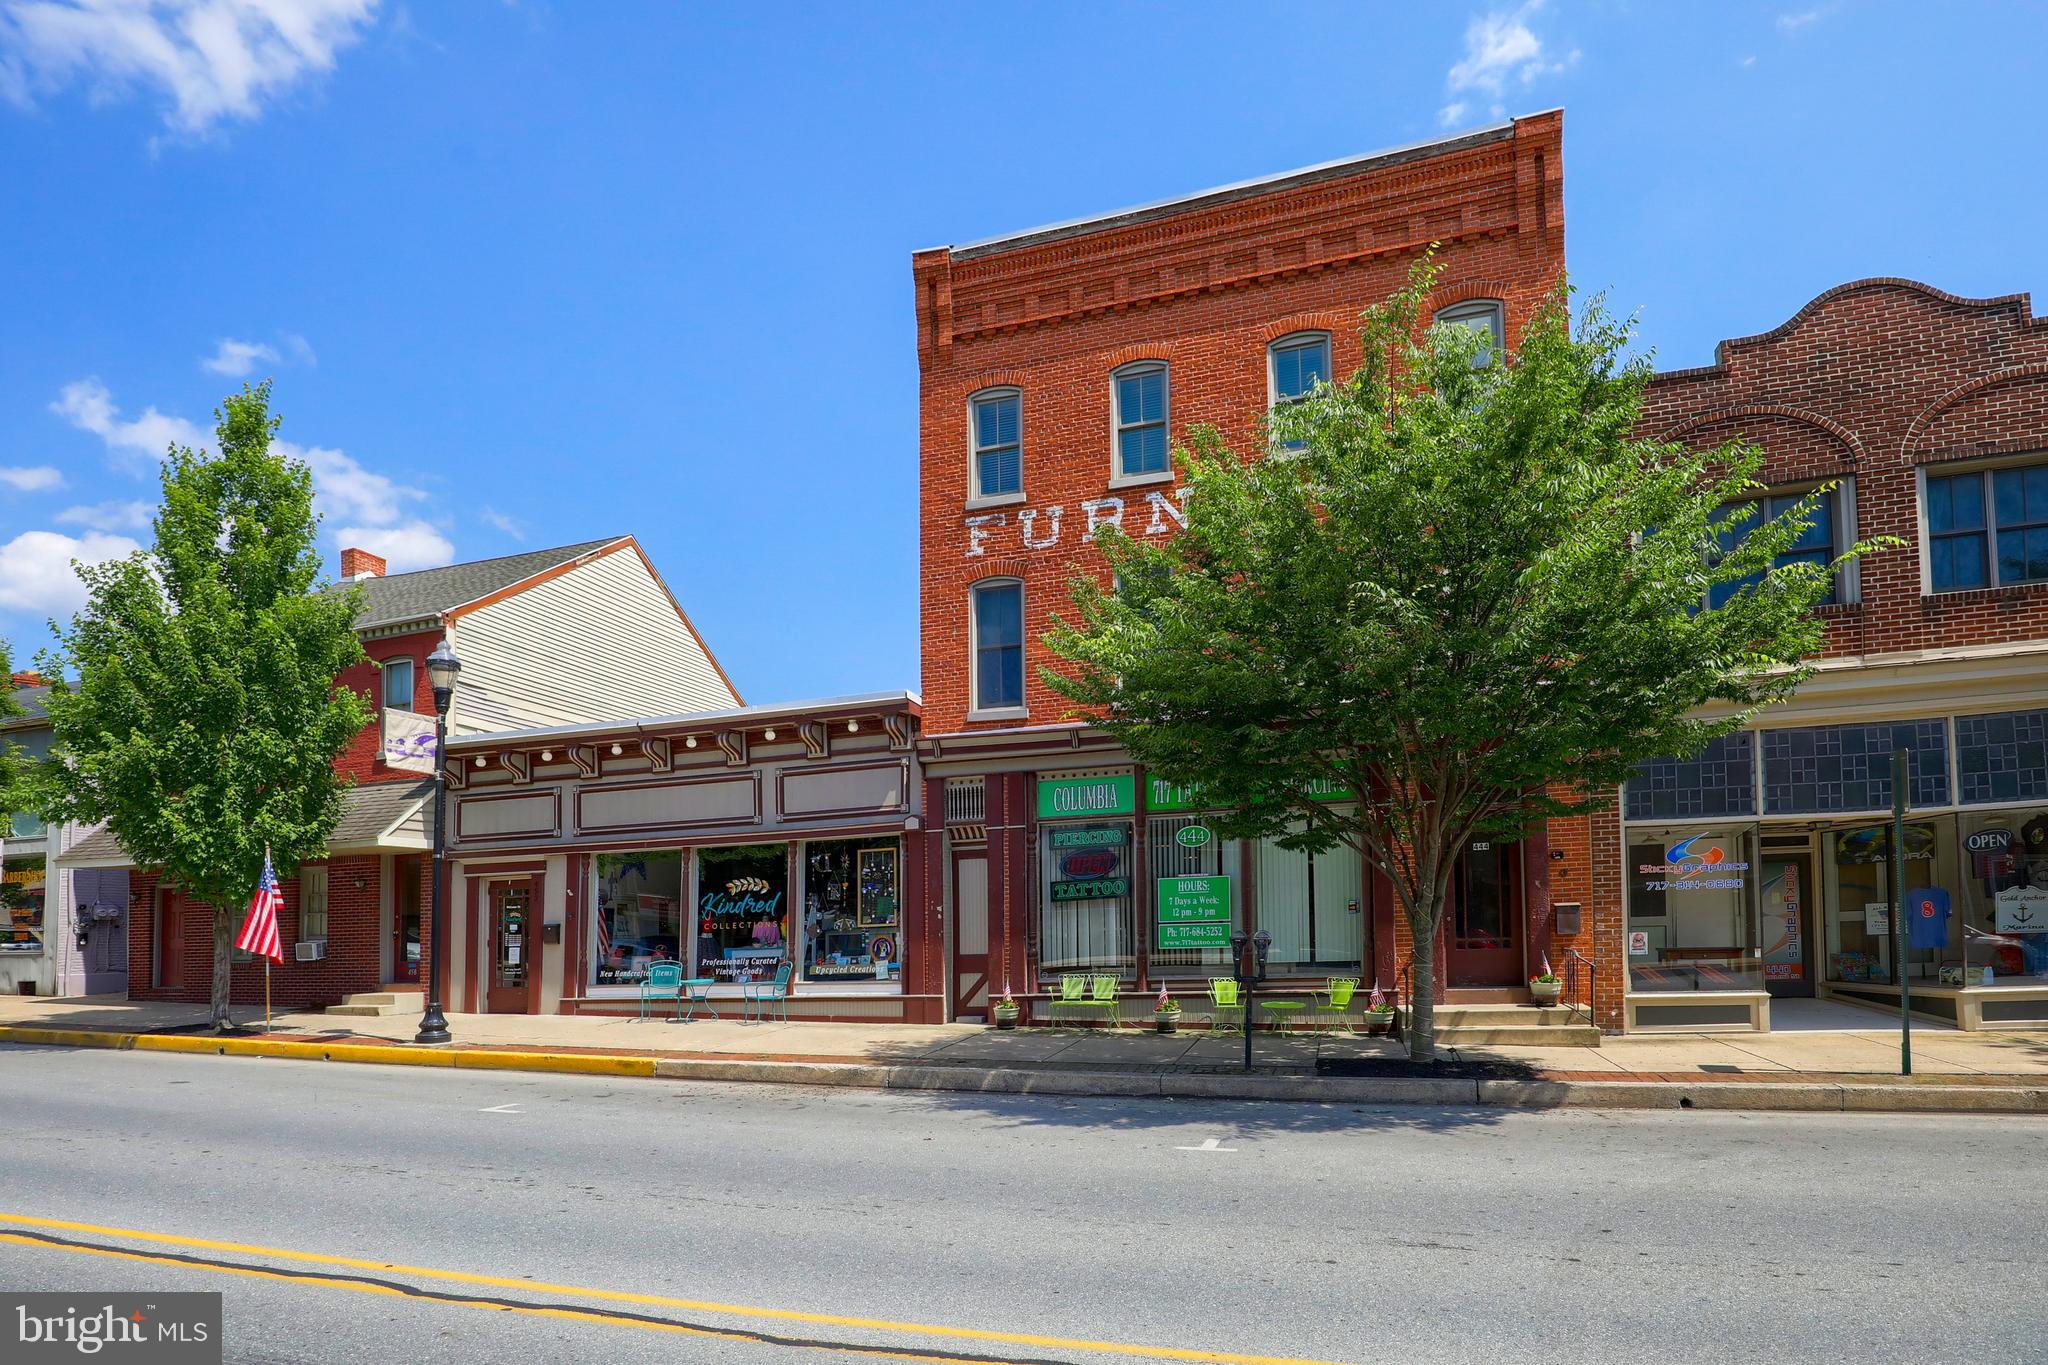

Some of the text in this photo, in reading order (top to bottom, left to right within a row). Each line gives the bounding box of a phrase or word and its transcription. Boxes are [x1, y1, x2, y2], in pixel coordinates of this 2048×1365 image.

[1053, 784, 1118, 812] COLUMBIA
[1153, 780, 1171, 804] 717
[1053, 830, 1122, 846] PIERCING
[1179, 829, 1205, 842] 444
[1968, 833, 2008, 849] OPEN
[1473, 842, 1490, 850] 444
[1639, 862, 1749, 875] StickyGraphics
[1055, 881, 1125, 898] TATTOO
[1178, 880, 1210, 892] HOURS:
[1646, 879, 1744, 891] 717-314-0680
[700, 892, 782, 921] Kindred
[1174, 896, 1191, 907] Days
[1172, 908, 1180, 917] 12
[1181, 909, 1192, 918] pm
[1198, 907, 1203, 916] 9
[1204, 908, 1216, 917] pm
[1921, 901, 1935, 918] 8
[703, 921, 778, 931] COLLECTIONS
[1179, 926, 1223, 937] 717-684-5252
[701, 957, 777, 967] Professionally Curated
[599, 970, 614, 978] New
[655, 969, 674, 977] Items
[715, 966, 763, 976] Vintage Goods
[815, 965, 849, 975] Upcycled
